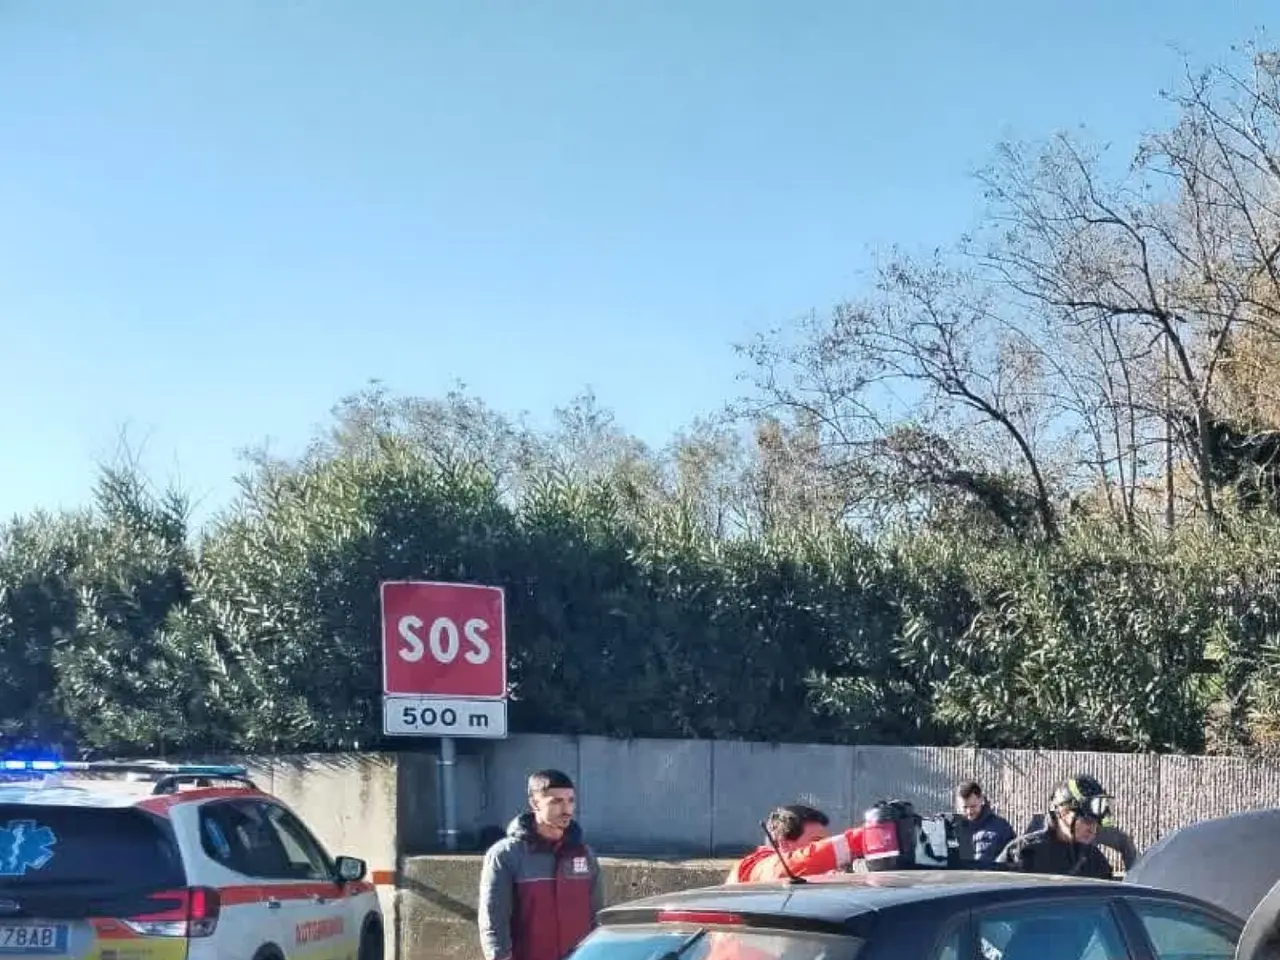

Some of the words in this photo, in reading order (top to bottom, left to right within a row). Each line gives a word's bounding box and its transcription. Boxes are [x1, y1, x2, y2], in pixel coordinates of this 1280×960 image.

[398, 615, 490, 664] SOS
[402, 707, 457, 726] 500
[468, 714, 489, 727] m
